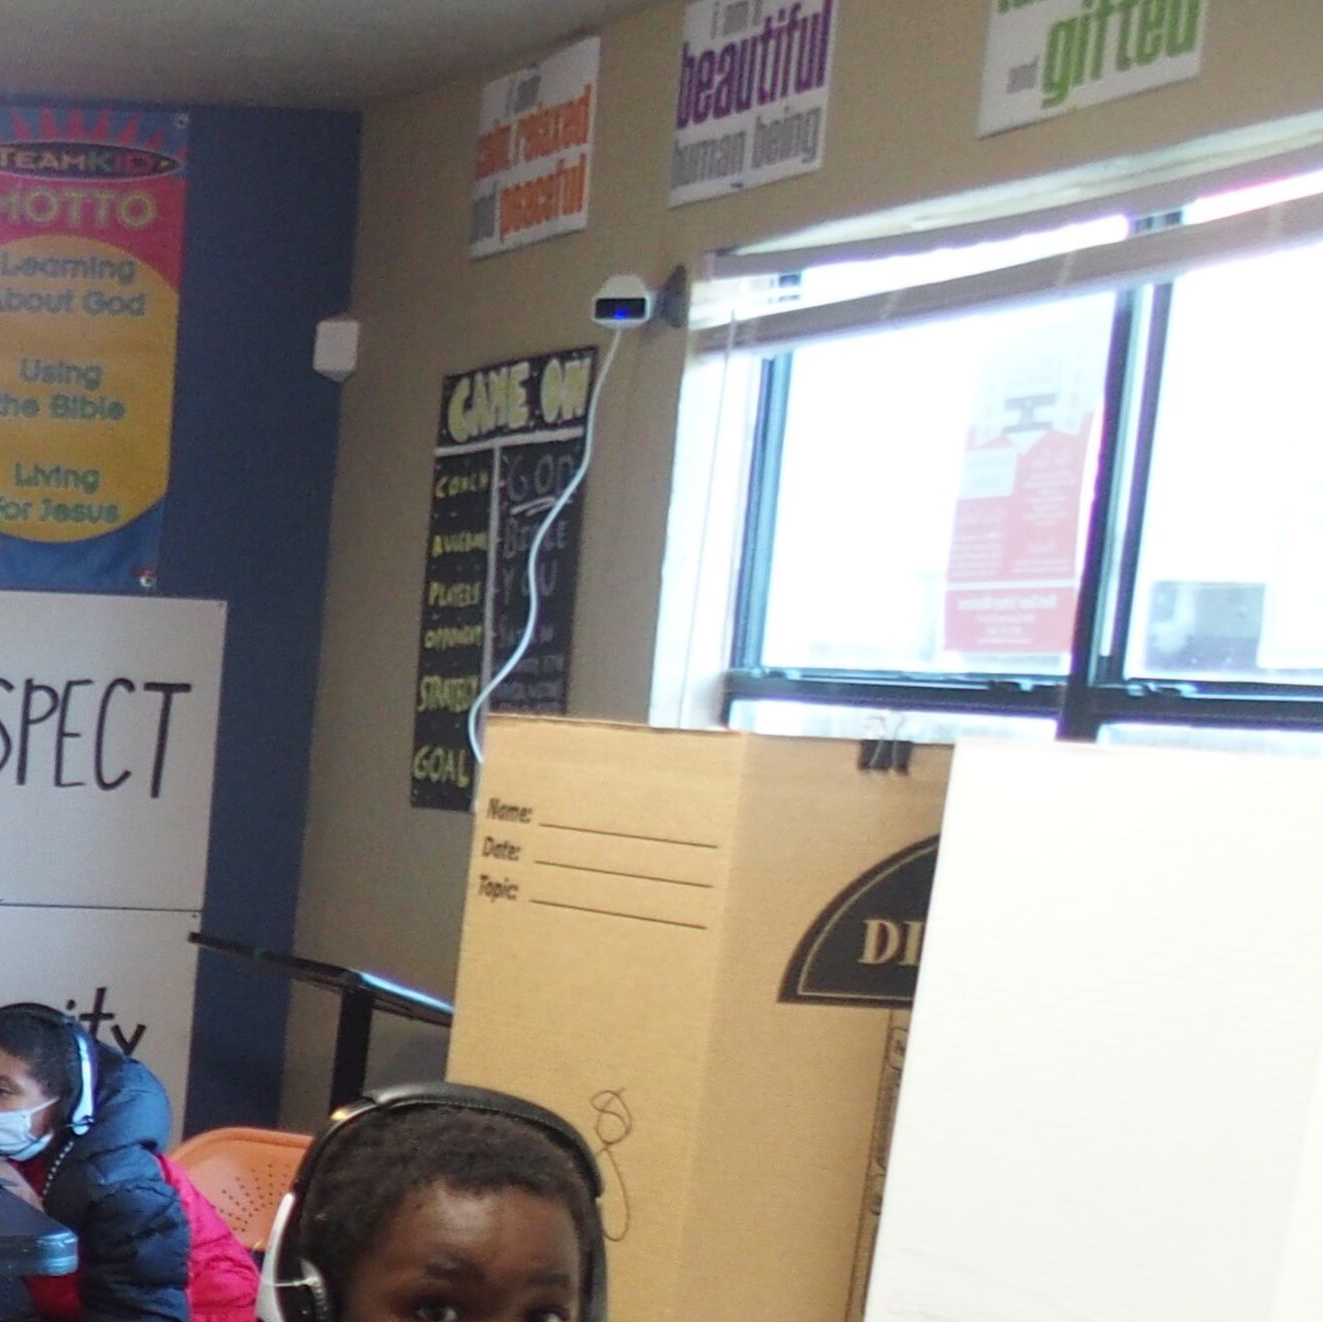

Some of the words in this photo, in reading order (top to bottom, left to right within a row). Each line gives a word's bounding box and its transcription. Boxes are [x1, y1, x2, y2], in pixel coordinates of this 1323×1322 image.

[678, 0, 833, 129] beautiful
[0, 252, 136, 285] Learning
[82, 291, 147, 318] God
[19, 358, 103, 389] Using
[49, 393, 126, 422] Bible
[14, 463, 100, 491] Living
[40, 498, 120, 525] Jesus
[413, 745, 469, 788] GOAL
[486, 797, 533, 825] Name:
[482, 836, 522, 862] Date:
